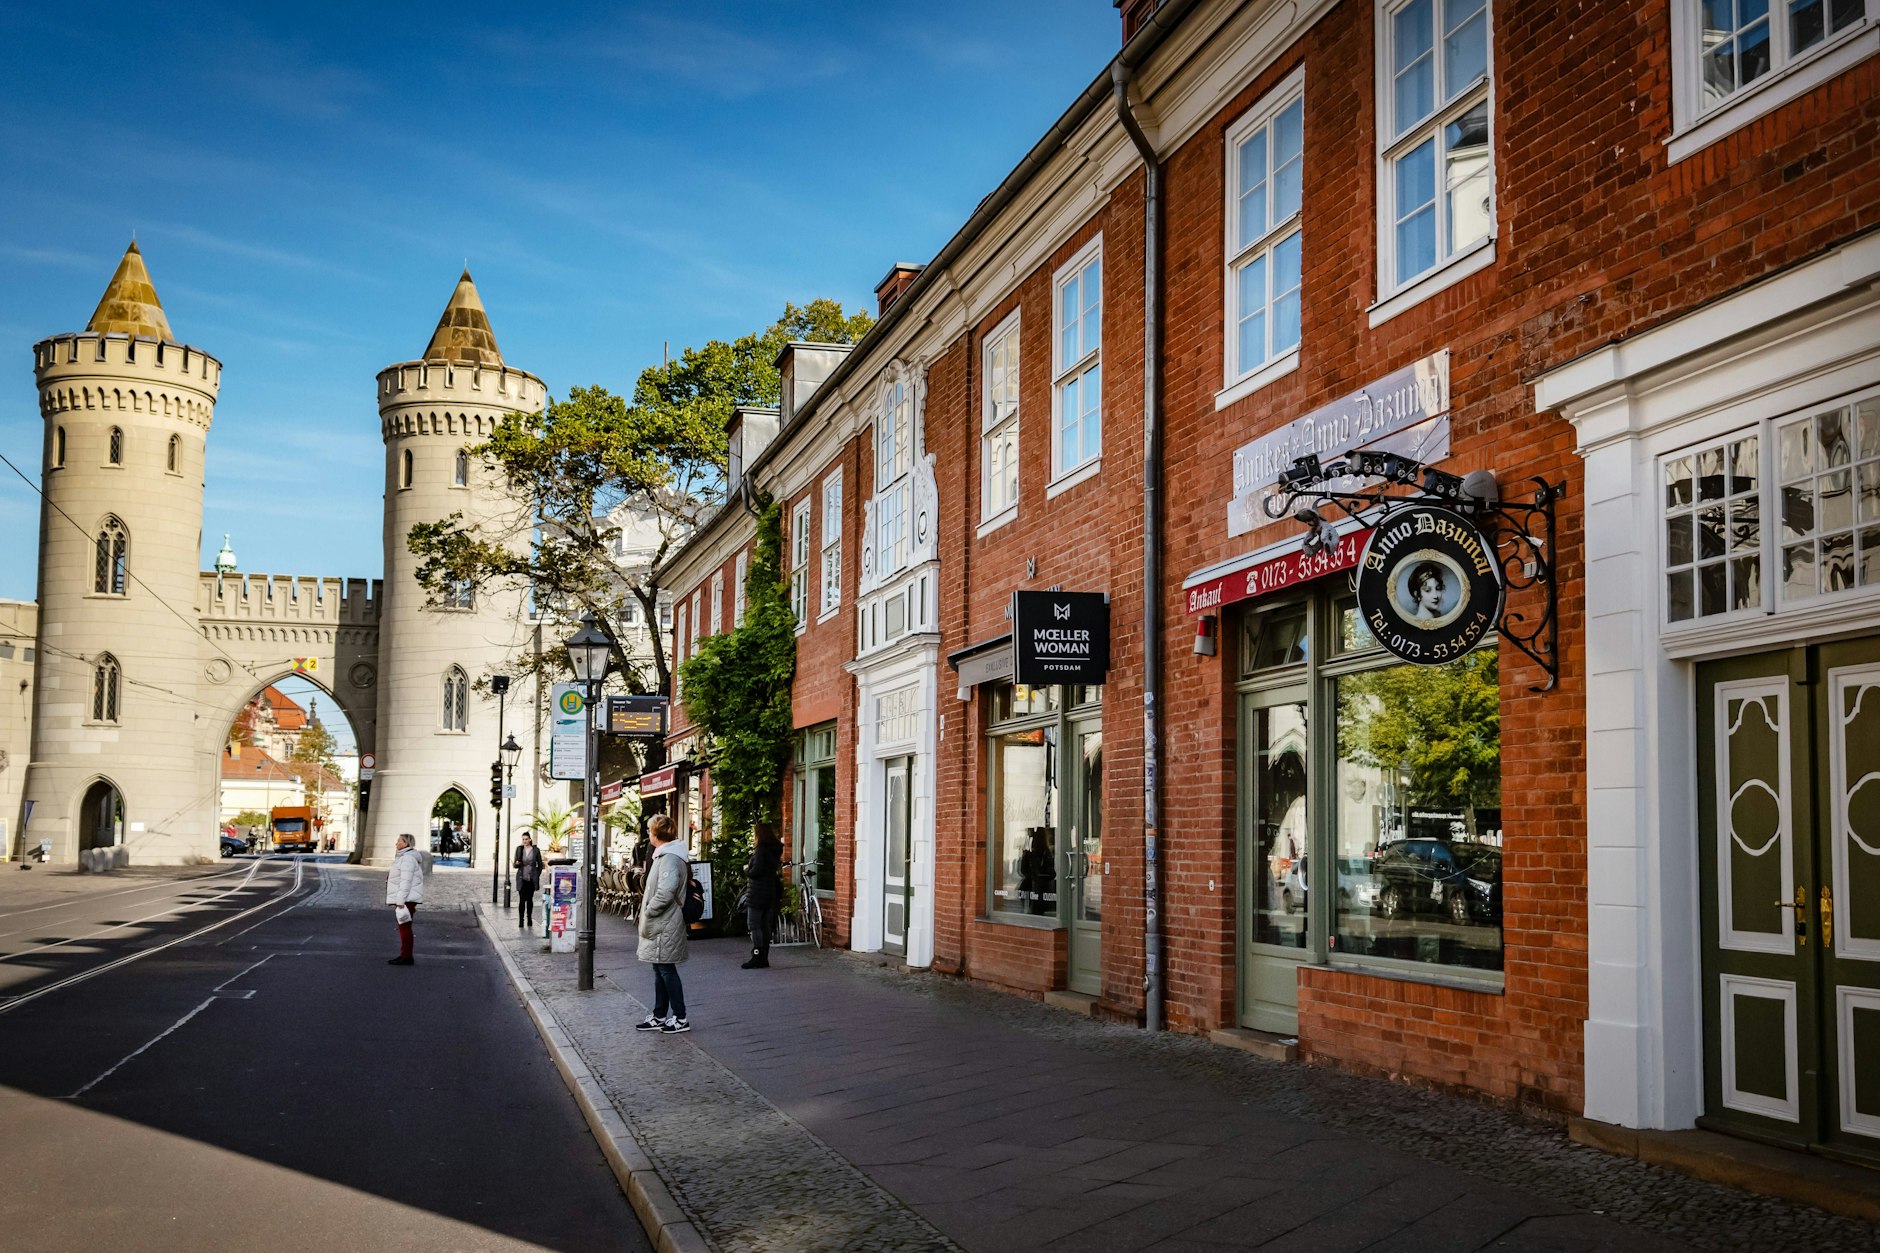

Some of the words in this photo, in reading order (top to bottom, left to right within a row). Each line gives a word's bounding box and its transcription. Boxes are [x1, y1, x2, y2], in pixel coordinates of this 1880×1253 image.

[1234, 434, 1291, 491] Antikes
[1301, 414, 1350, 456] Anno
[1354, 359, 1449, 440] Dazumal
[1365, 521, 1413, 574] Anno
[1412, 512, 1493, 577] Dazumal
[1188, 582, 1223, 614] Ankauf
[1261, 560, 1288, 590] 0173
[1033, 628, 1091, 642] MŒLLER
[1033, 641, 1090, 655] WOMAN
[1369, 608, 1392, 640] Tel.:
[1391, 634, 1421, 658] 0173
[310, 660, 316, 669] 2
[1043, 664, 1082, 672] POTSDAM
